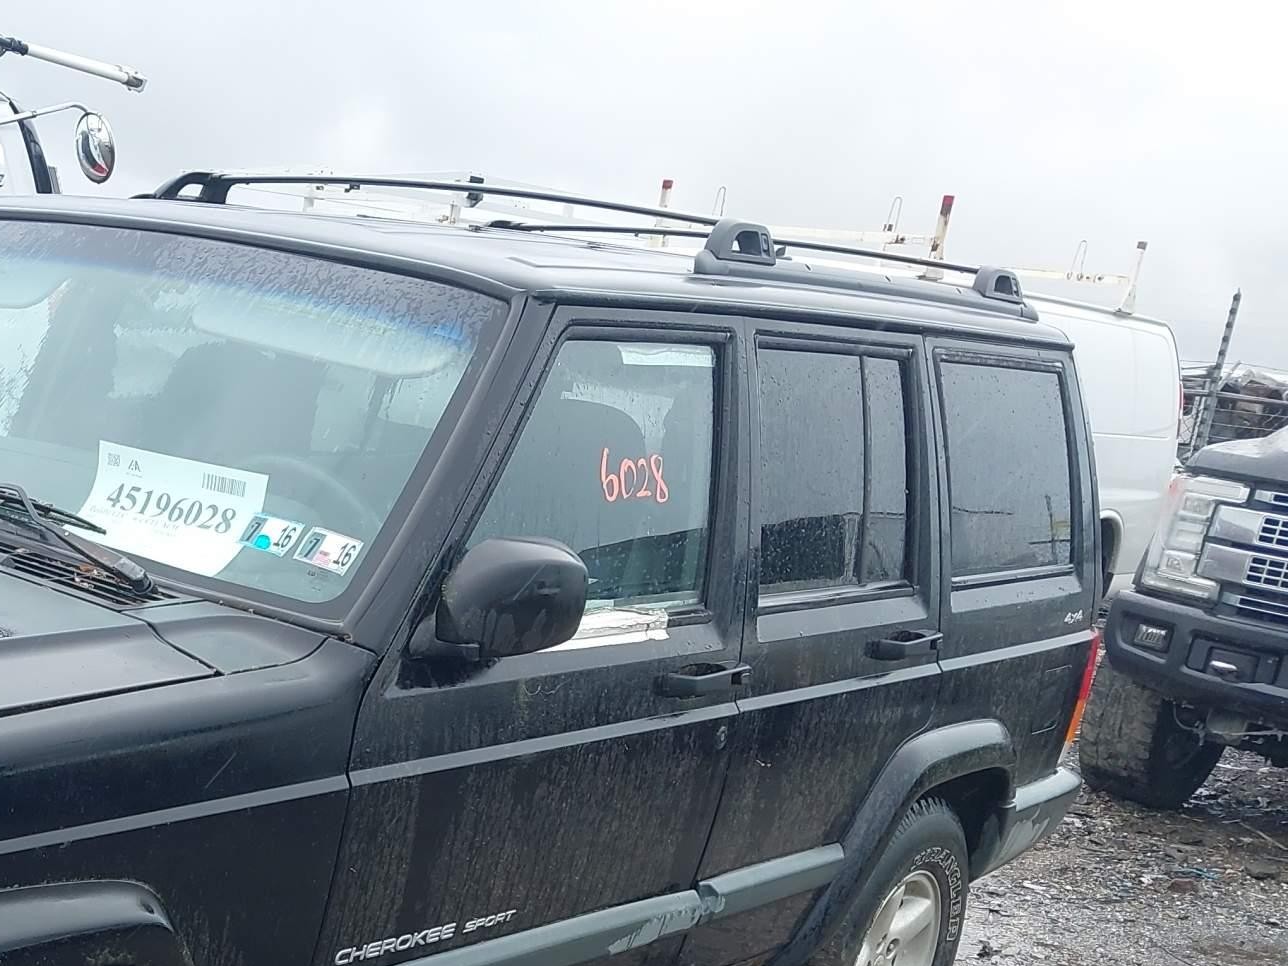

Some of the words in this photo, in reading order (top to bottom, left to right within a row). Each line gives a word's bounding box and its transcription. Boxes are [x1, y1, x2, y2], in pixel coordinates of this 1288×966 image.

[601, 447, 669, 503] 6028
[106, 482, 237, 534] 45196028
[273, 525, 297, 549] 16
[332, 542, 357, 567] 16
[334, 922, 457, 966] CHEROKEE
[463, 909, 517, 935] SPORT
